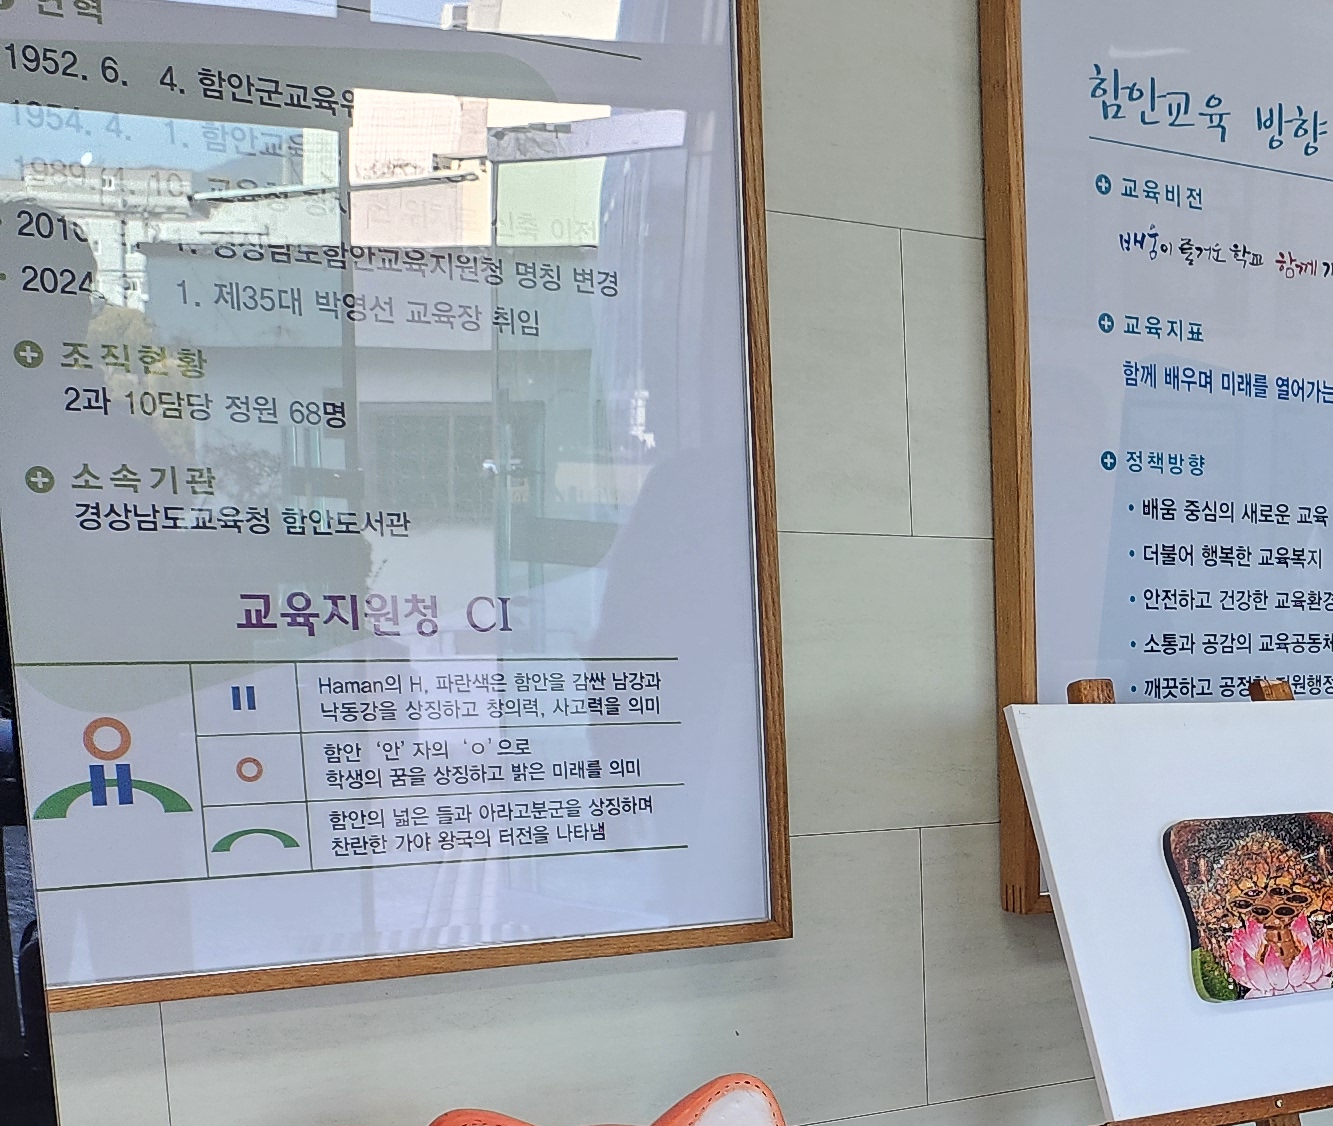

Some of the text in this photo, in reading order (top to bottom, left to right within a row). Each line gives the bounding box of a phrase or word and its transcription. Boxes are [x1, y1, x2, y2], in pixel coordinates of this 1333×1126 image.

[5, 43, 88, 81] 1952.
[101, 56, 128, 87] 6.
[160, 66, 185, 95] 4.
[1088, 64, 1329, 156] 함안교육 방향
[1121, 178, 1203, 211] 교육비전
[1229, 242, 1264, 269] 학교
[1275, 251, 1318, 279] 함께
[515, 262, 561, 290] 명칭
[572, 266, 619, 297] 변경
[214, 281, 302, 316] 제35대
[316, 290, 395, 324] 박영선
[406, 302, 481, 331] 교육장
[492, 307, 539, 337] 취임
[1123, 313, 1205, 343] 교육지표
[60, 341, 207, 378] 조직현황
[1123, 361, 1157, 390] 함께
[1164, 368, 1214, 395] 배우며
[1221, 372, 1269, 399] 미래를
[65, 387, 347, 429] 2과 10담당 정원 68명
[71, 463, 217, 496] 소속기관
[1125, 450, 1206, 477] 정책방향
[75, 501, 411, 537] 경상남도교육청 함안도서관
[1142, 498, 1329, 528] 배움 중심의 새로운 교육
[1143, 544, 1323, 570] 더불어 행복한 교육복지
[237, 592, 512, 637] 교육지원청 CI
[1143, 589, 1212, 612] 안전하고
[1219, 589, 1269, 613] 건강한
[1143, 632, 1195, 655] 소통과
[1202, 632, 1253, 655] 공감의
[318, 671, 661, 696] Haman의 H, 파란색은 함안을 감싼 남강과
[1144, 677, 1213, 699] 깨끗하고
[320, 696, 661, 722] 낙동강을 상징하고 창의력, 사고력을 의미
[323, 743, 361, 763] 함안
[326, 758, 641, 789] 학생의 꿈을 상징하고 밝은 미래를 의미
[329, 796, 653, 831] 함안의 넓은 들과 아라고분군을 상징하며
[332, 822, 605, 857] 찬란한 가야 왕국의 터전을 나타냄
